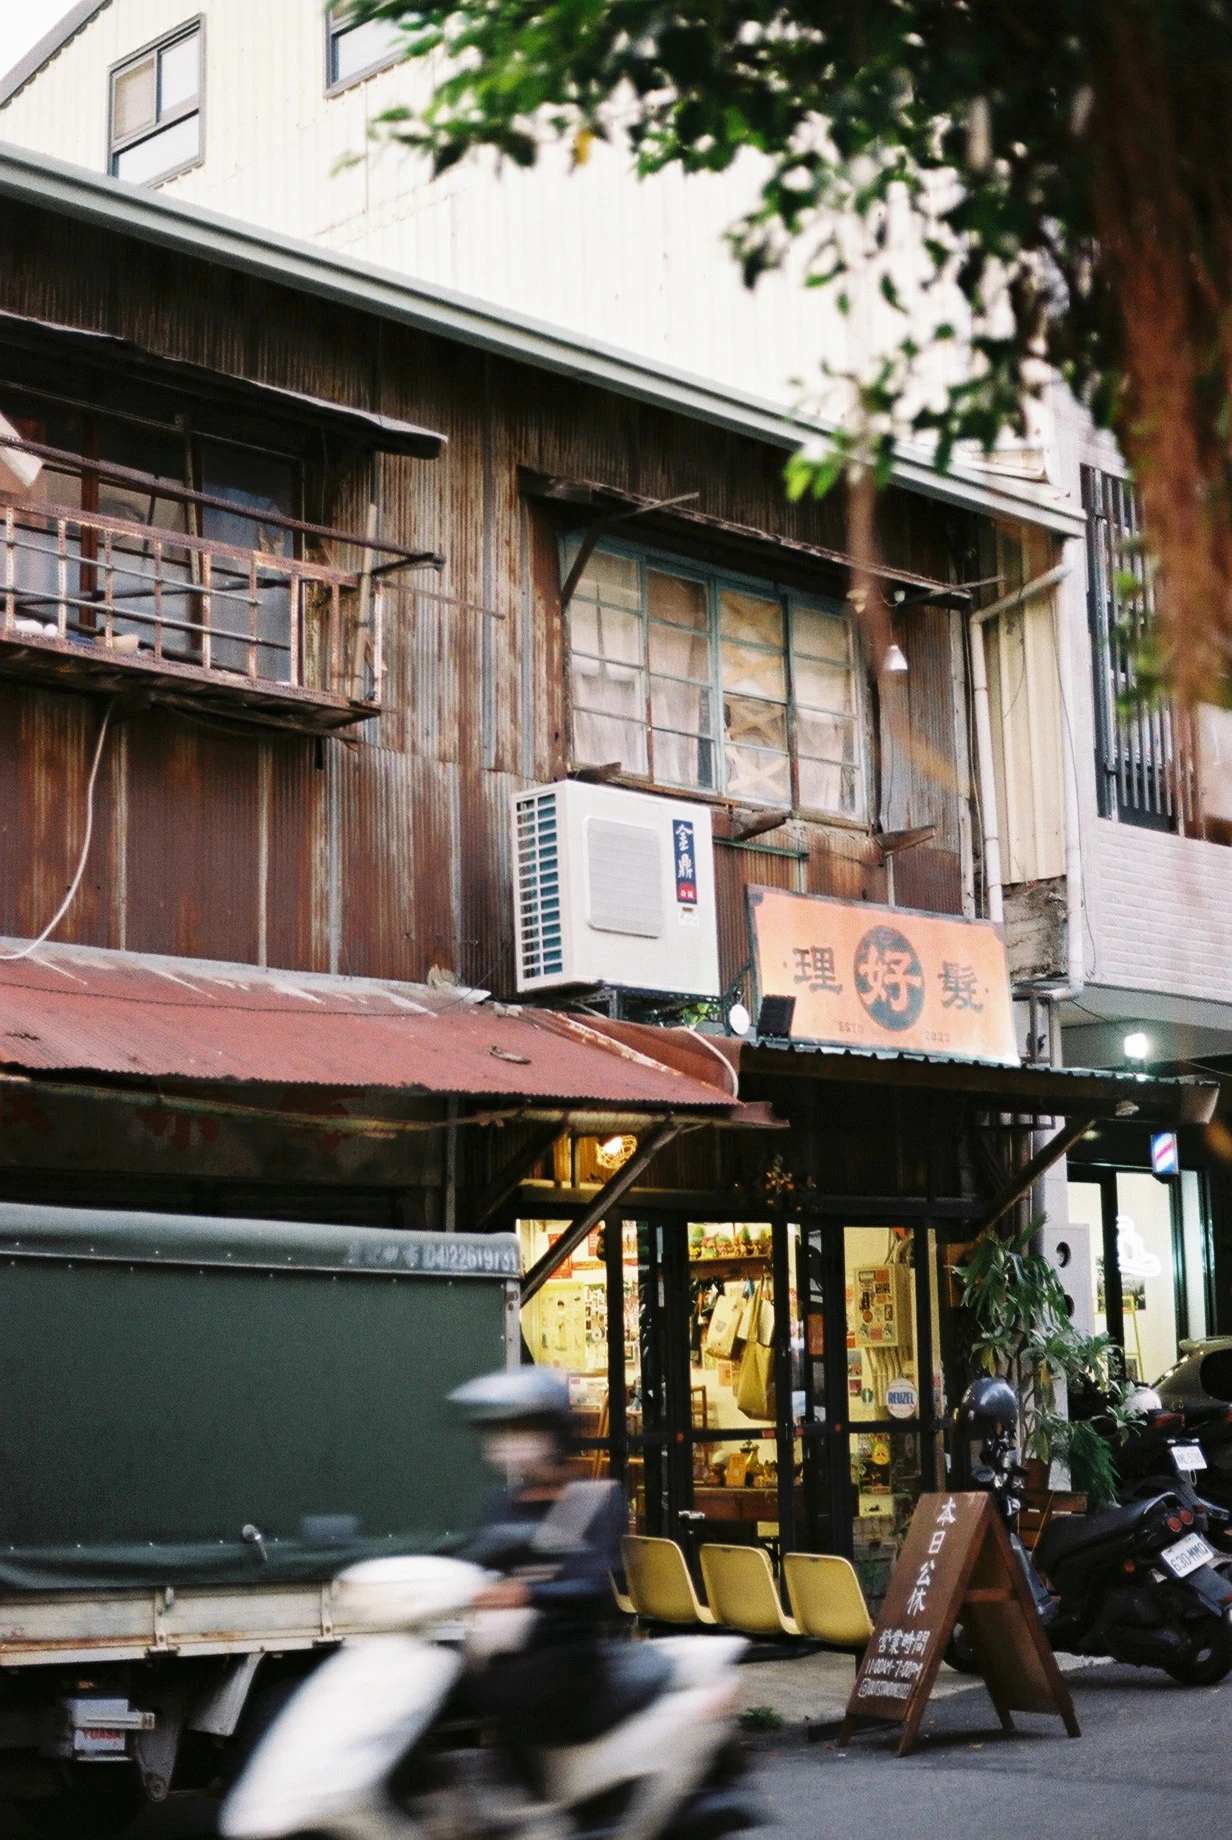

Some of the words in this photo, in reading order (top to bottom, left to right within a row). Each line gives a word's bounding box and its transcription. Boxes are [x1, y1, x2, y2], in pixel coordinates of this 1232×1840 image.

[675, 824, 694, 879] 金鼎
[925, 1029, 951, 1043] 2022
[888, 1391, 915, 1404] REUZEL
[906, 1496, 956, 1616] 本日公休
